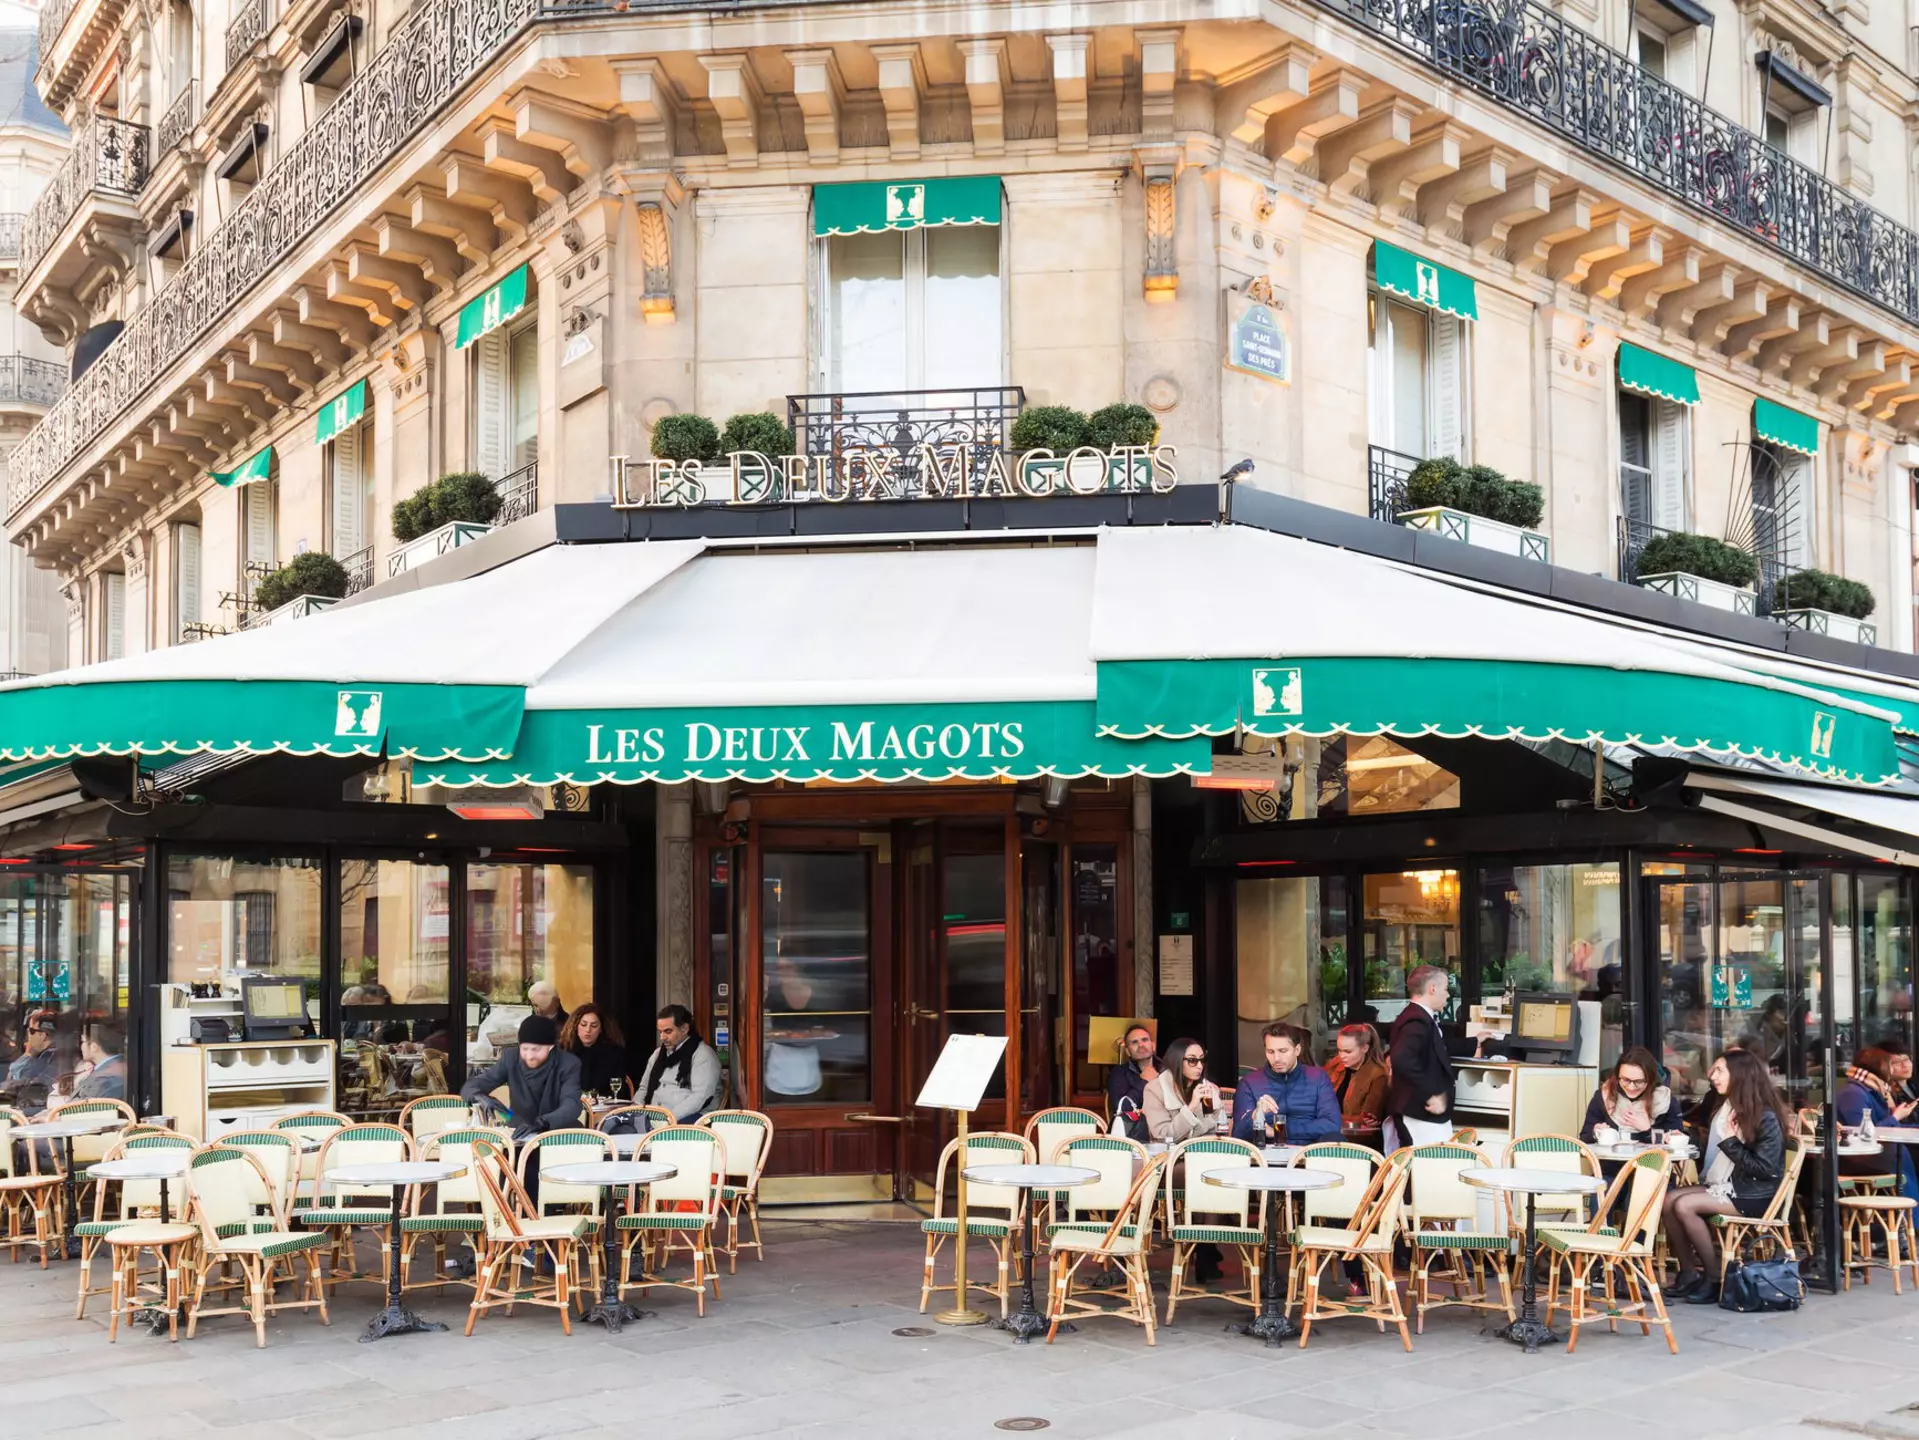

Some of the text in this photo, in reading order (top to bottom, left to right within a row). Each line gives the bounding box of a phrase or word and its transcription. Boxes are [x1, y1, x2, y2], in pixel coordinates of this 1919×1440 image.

[1253, 331, 1271, 344] PLACE
[1248, 352, 1260, 364] DES
[609, 442, 1179, 509] LES DEUX MAGOTS
[585, 721, 1025, 763] LES DEUX MAGOTS
